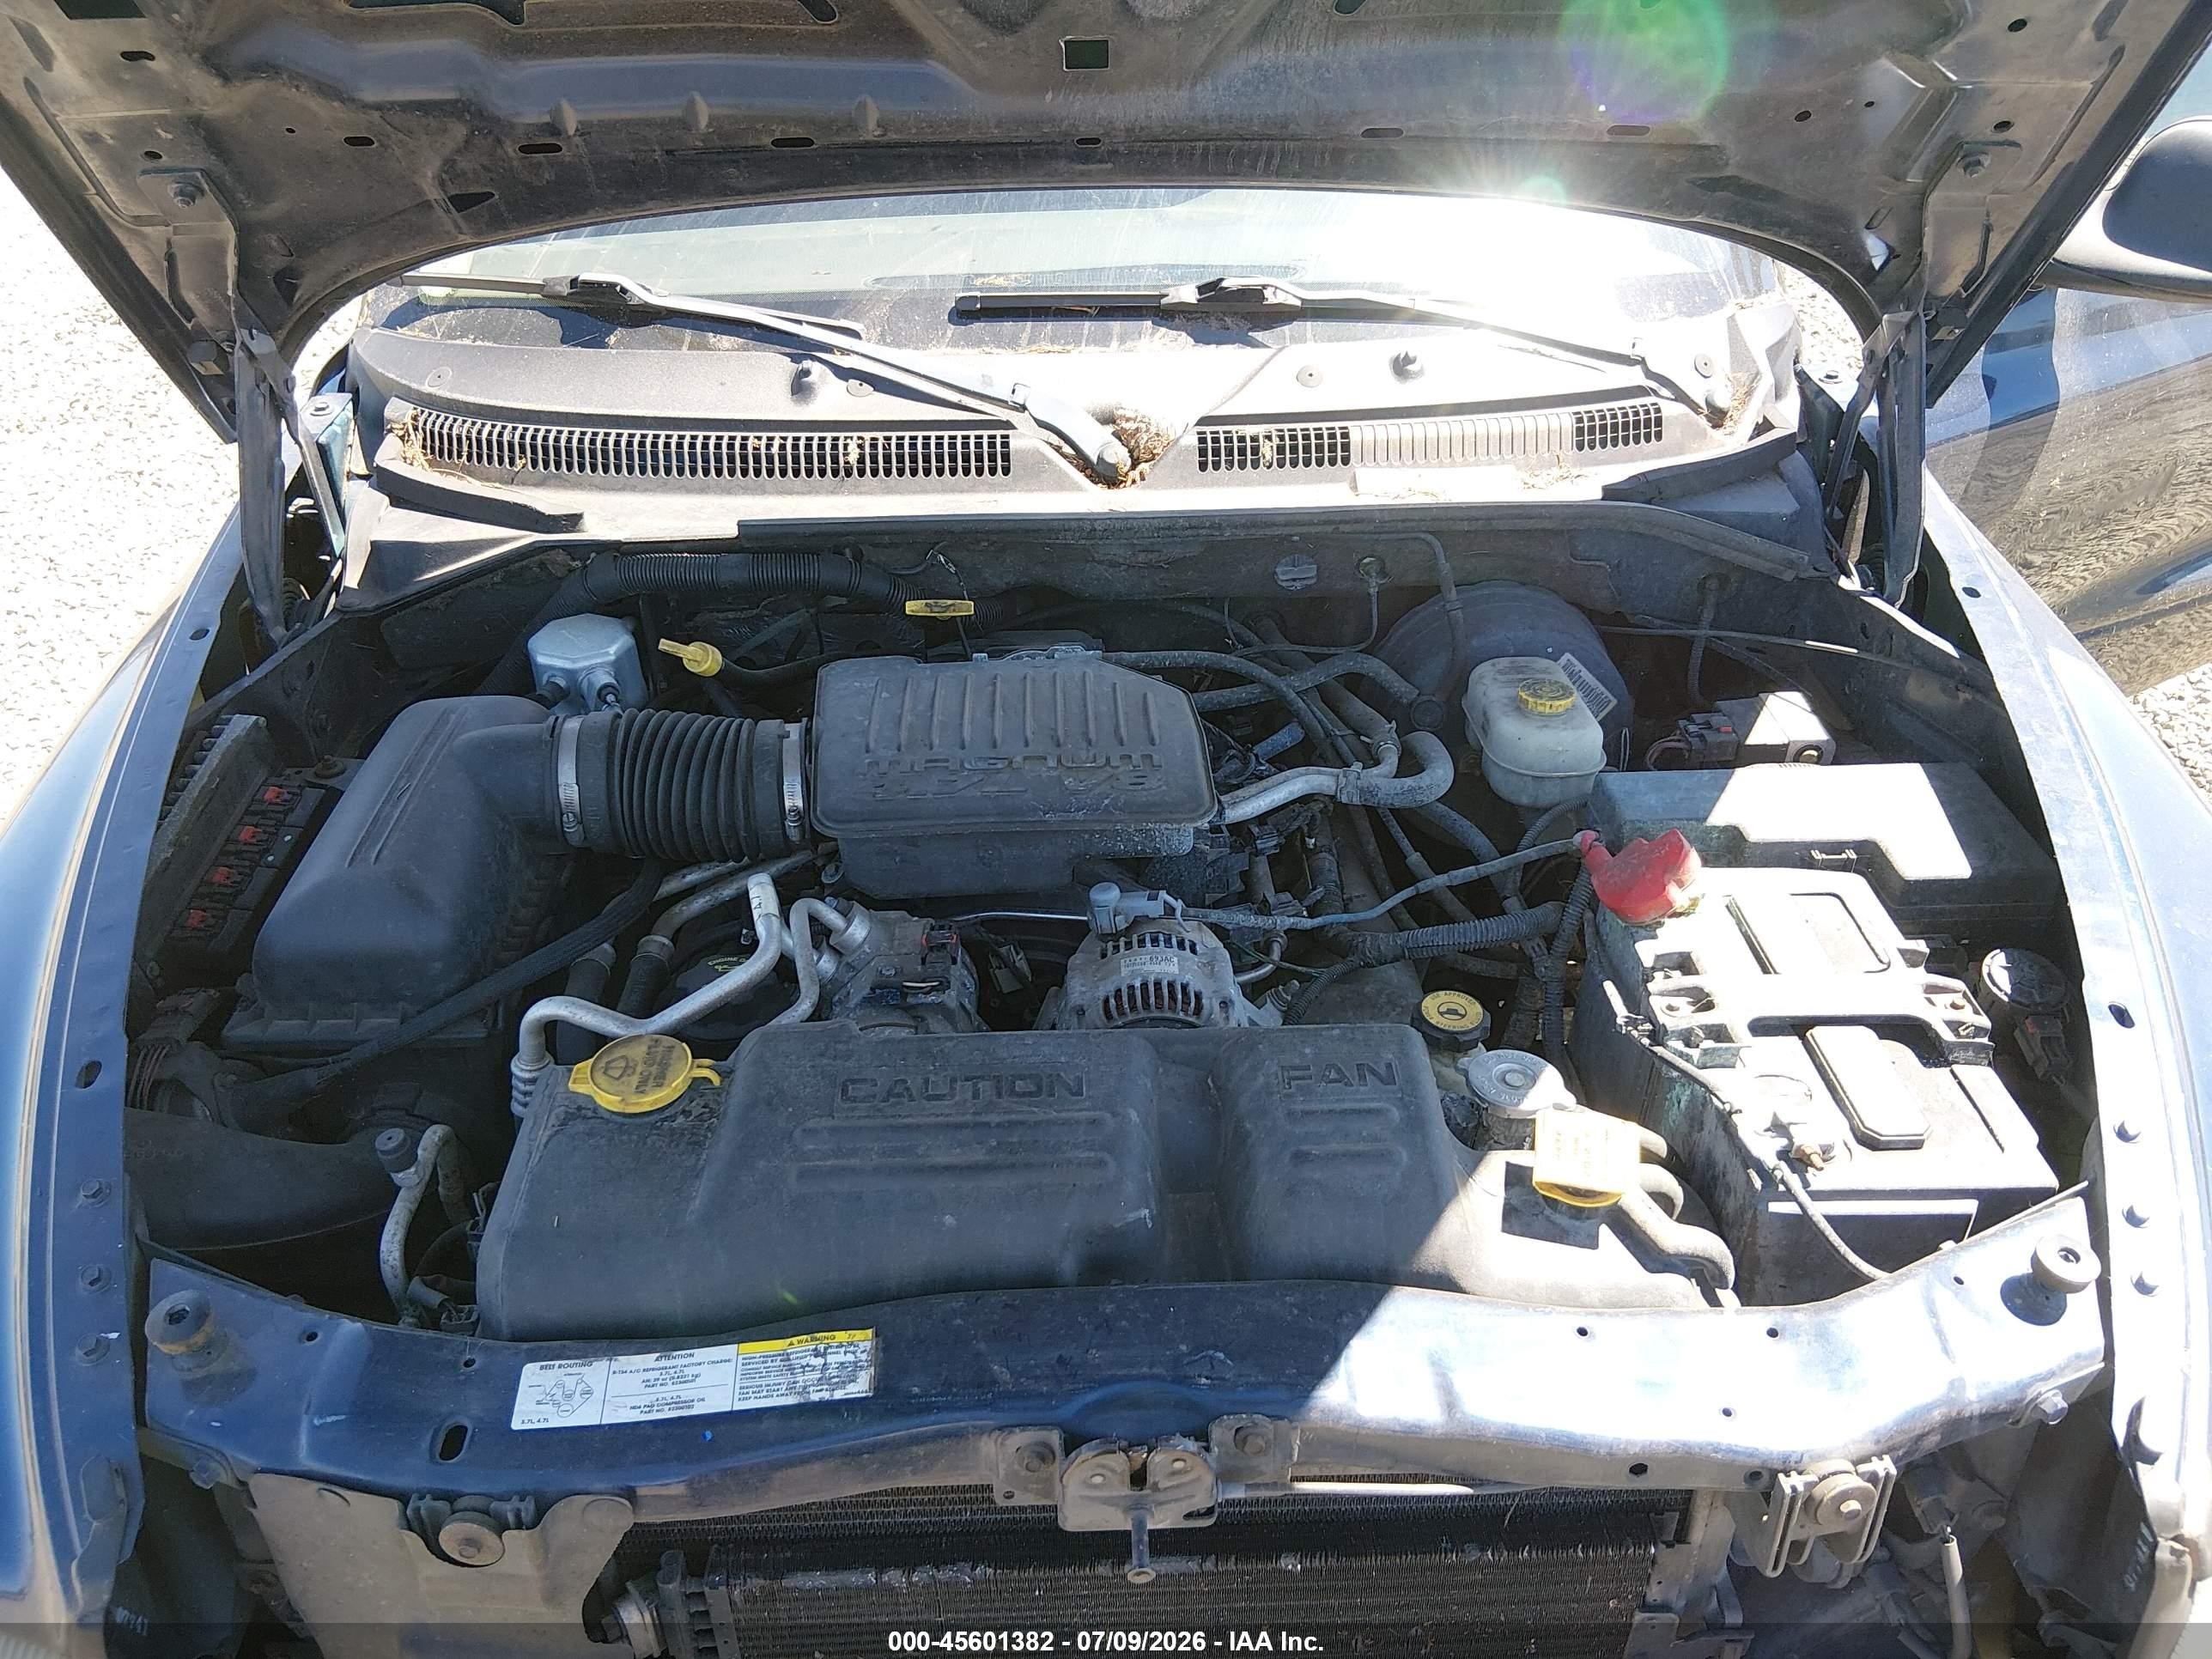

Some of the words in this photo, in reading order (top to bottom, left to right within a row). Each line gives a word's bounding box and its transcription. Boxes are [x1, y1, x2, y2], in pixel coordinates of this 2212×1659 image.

[864, 754, 1164, 775] MAGNUM
[708, 957, 738, 966] ENGINE
[1443, 992, 1476, 1006] APPROVED
[1279, 1061, 1399, 1091] FAN
[838, 1072, 1085, 1104] CAUTION
[797, 1334, 836, 1345] WARNING
[654, 1352, 695, 1362] ATTENTION
[557, 1361, 593, 1370] ROUTING
[656, 1399, 695, 1407] COMPRESSOR
